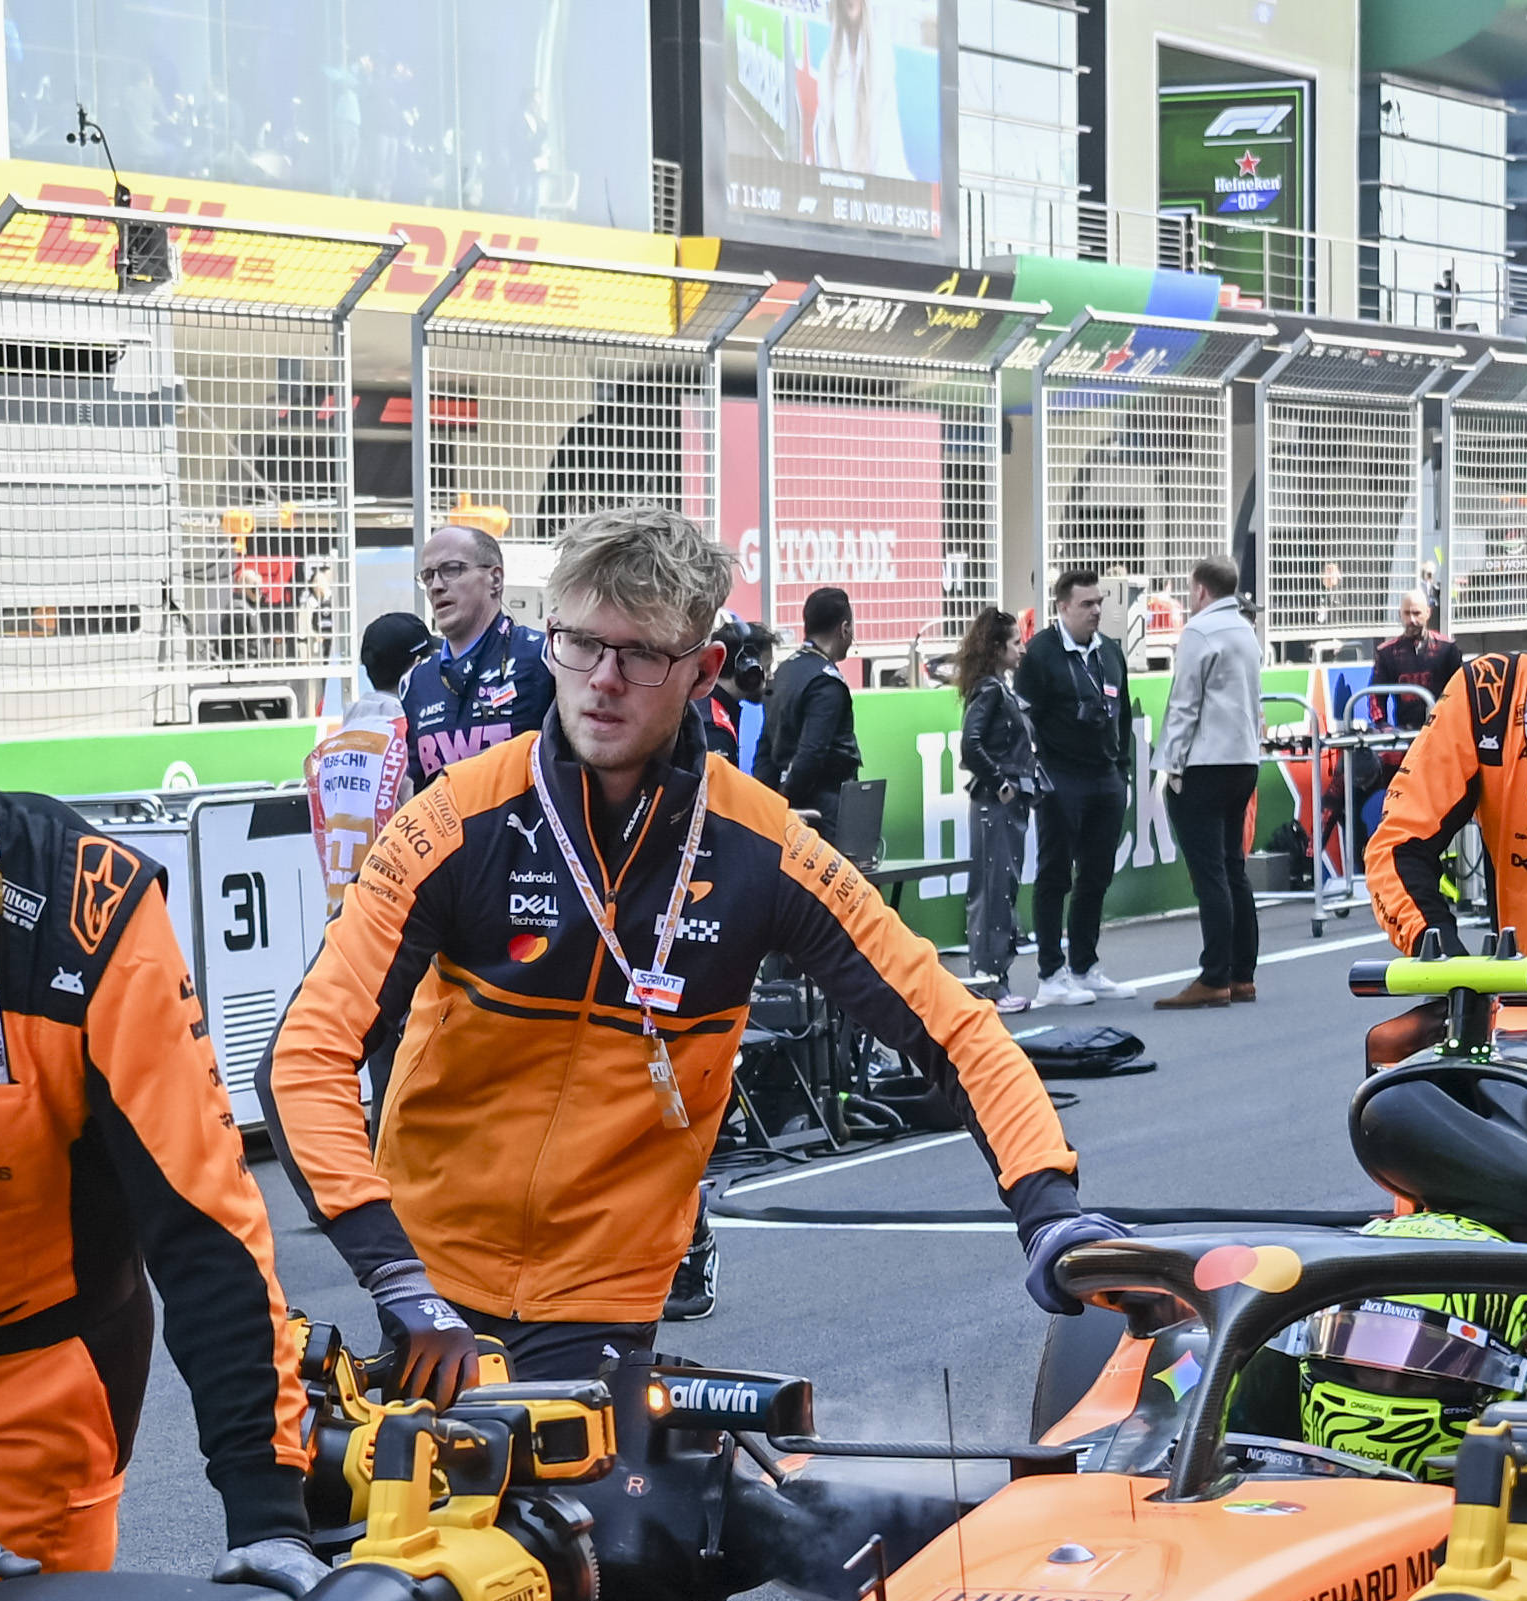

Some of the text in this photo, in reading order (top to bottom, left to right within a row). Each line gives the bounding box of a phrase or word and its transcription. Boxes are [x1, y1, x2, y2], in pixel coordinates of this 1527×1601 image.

[1214, 176, 1282, 193] Heineken
[833, 197, 849, 219] BE
[850, 200, 864, 221] IN
[865, 202, 894, 226] YOUR
[896, 205, 929, 231] SEATS
[739, 528, 898, 584] GTORADE
[417, 722, 514, 776] BWT
[376, 737, 405, 810] CHINA
[395, 815, 434, 860] okta
[509, 871, 553, 883] Android
[222, 870, 270, 953] 31
[510, 894, 559, 916] DELL
[637, 970, 681, 989] SPRINT
[1360, 1299, 1420, 1320] JACK DANIEL'S
[669, 1379, 758, 1413] all win
[1245, 1448, 1304, 1468] NORRIS 1
[1338, 1443, 1388, 1462] Android
